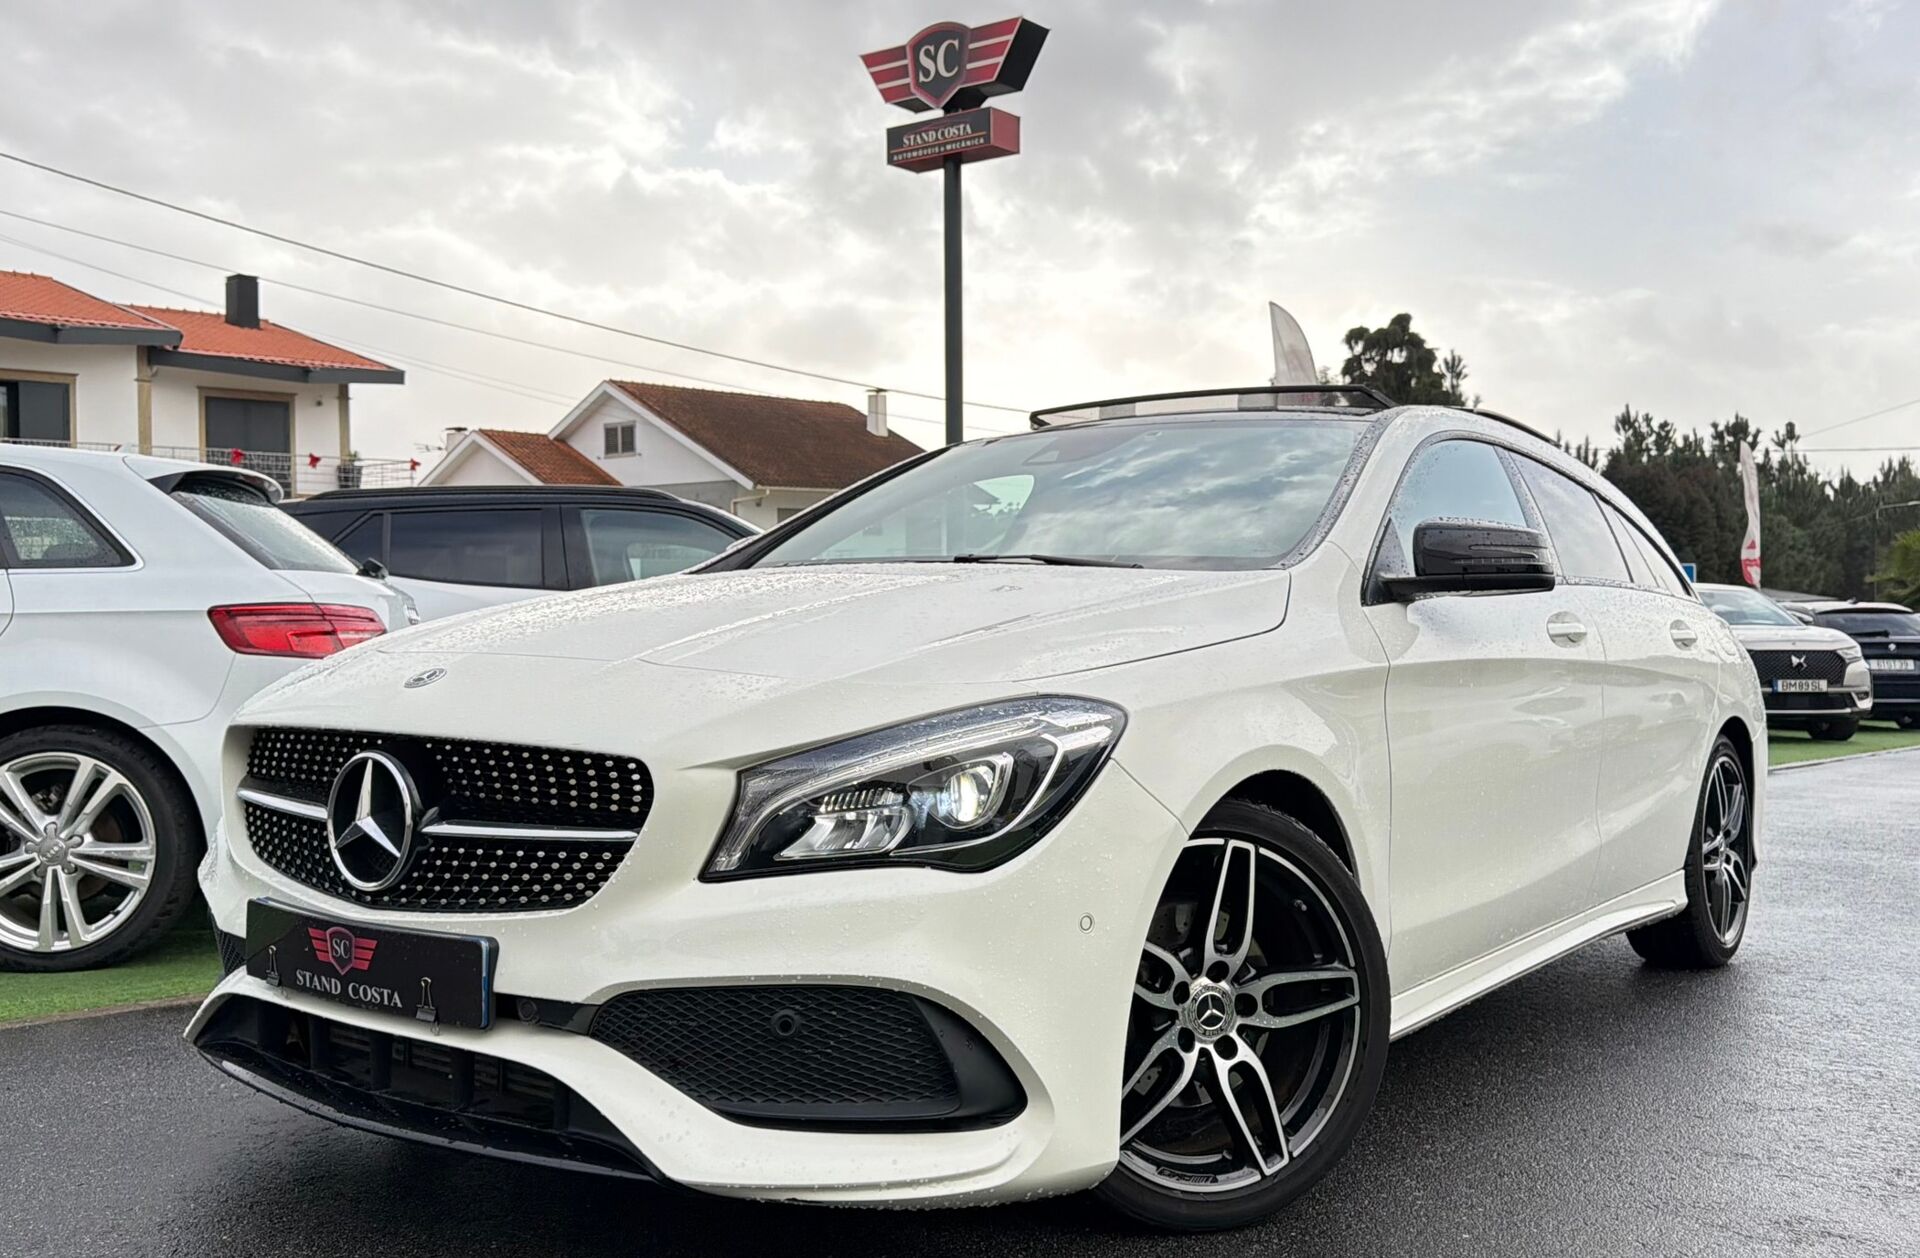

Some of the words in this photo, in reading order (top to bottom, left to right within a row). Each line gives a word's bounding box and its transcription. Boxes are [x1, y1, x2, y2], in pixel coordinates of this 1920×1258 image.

[919, 39, 959, 82] SC
[903, 130, 936, 147] STAND
[937, 124, 972, 140] COSTA
[893, 146, 939, 160] AUTOMÓVEIS
[945, 137, 984, 150] MECÂNICA
[332, 938, 350, 959] SC
[296, 969, 342, 995] STAND
[348, 982, 403, 1008] COSTA
